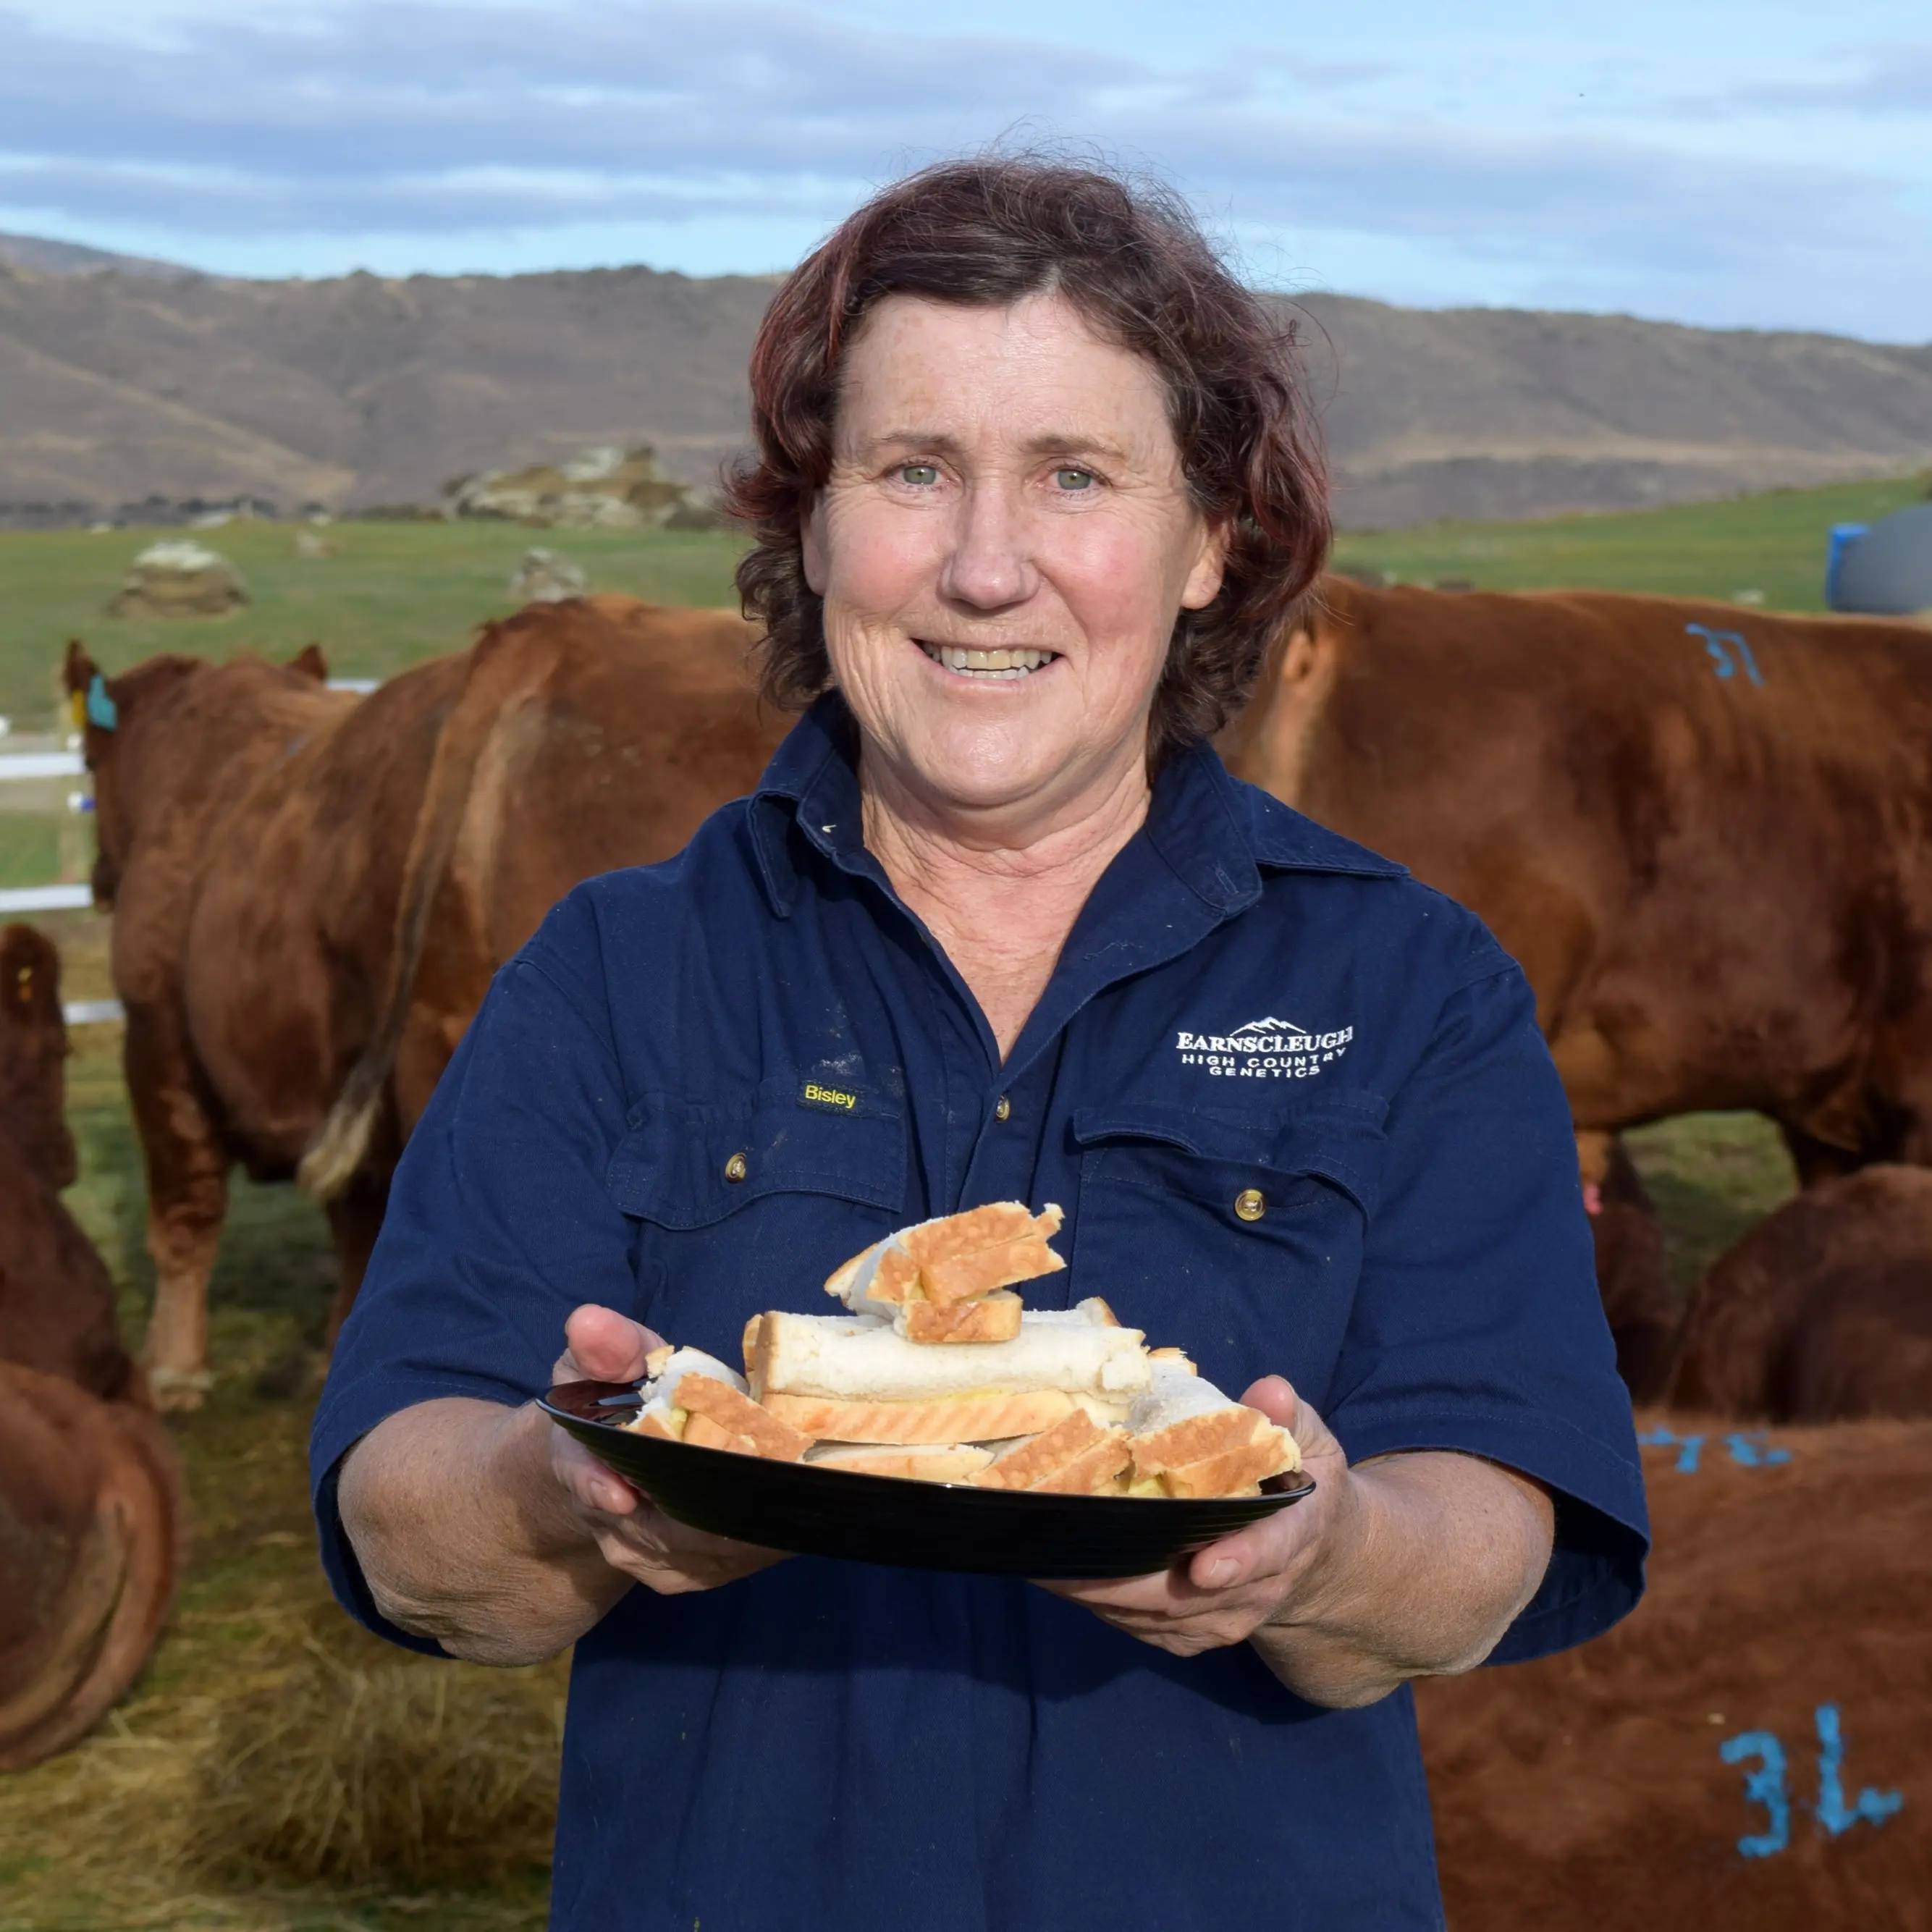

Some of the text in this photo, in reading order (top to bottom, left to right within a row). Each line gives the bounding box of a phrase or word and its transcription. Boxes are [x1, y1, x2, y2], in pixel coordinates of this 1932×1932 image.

[1176, 1026, 1353, 1053] EARNSCLEUGH
[1181, 1047, 1346, 1068] HIGH COUNTRY
[1209, 1066, 1320, 1078] GENETICS
[805, 1085, 856, 1108] Bisley
